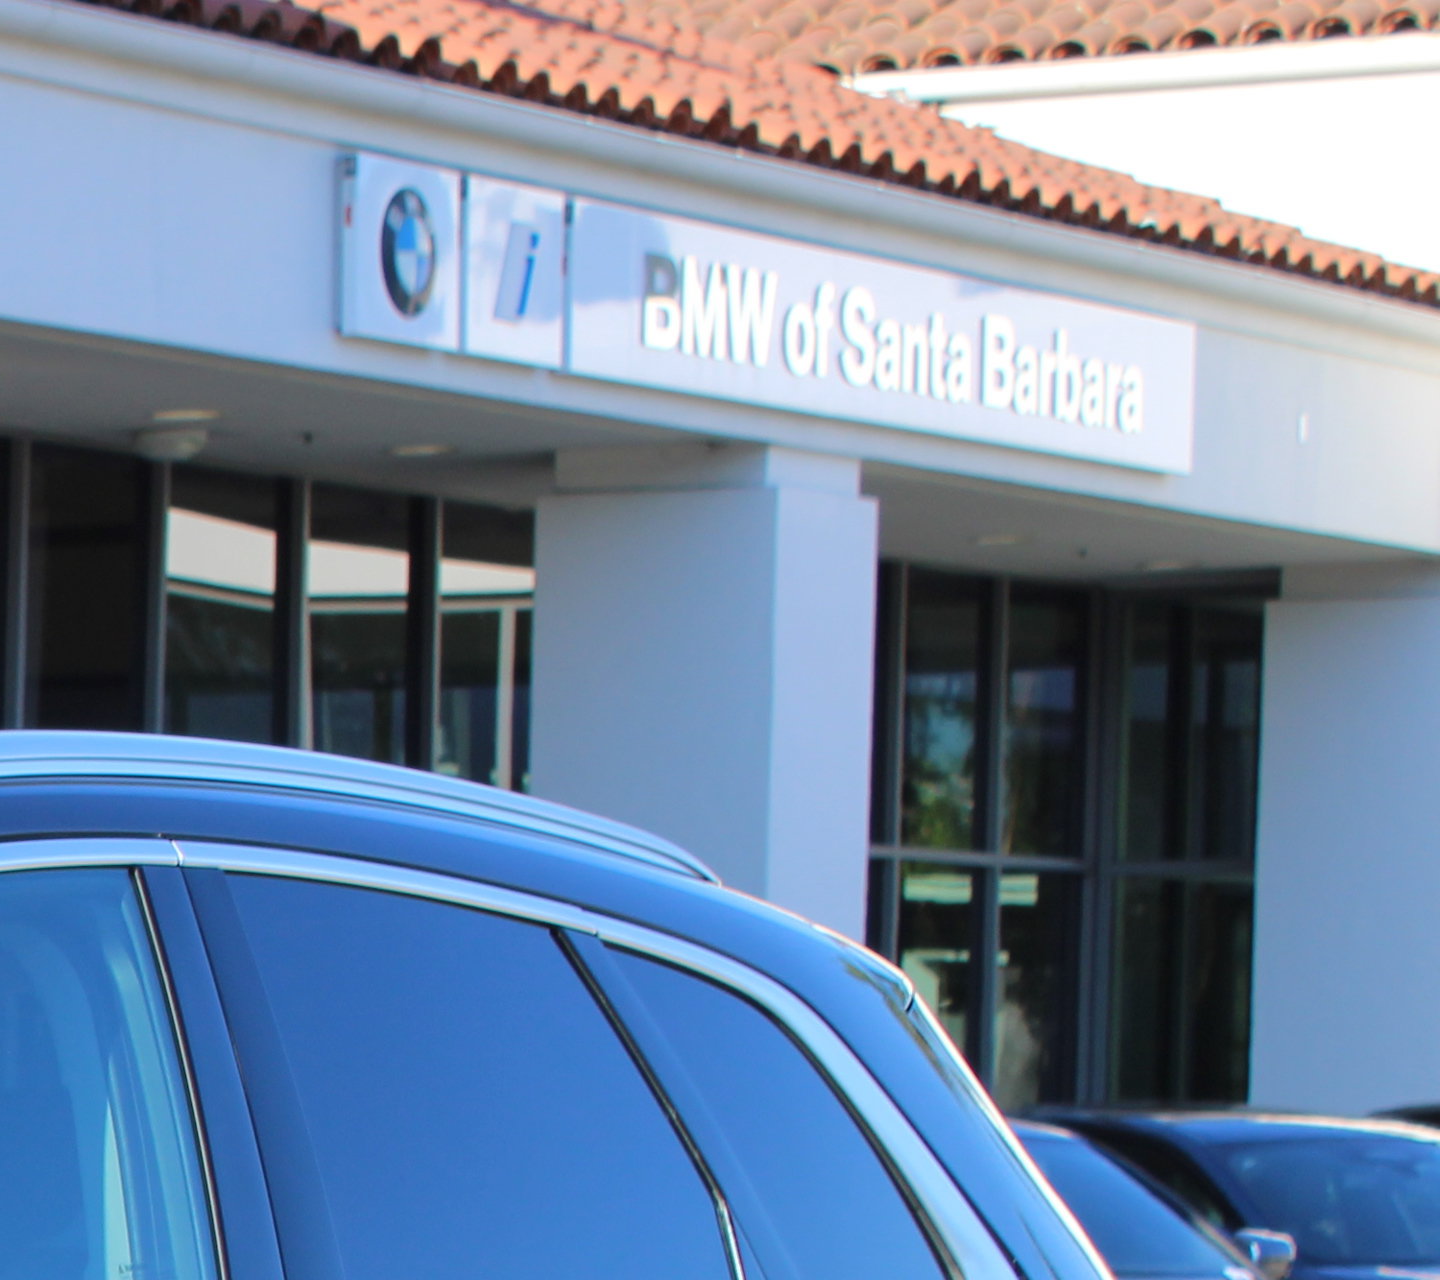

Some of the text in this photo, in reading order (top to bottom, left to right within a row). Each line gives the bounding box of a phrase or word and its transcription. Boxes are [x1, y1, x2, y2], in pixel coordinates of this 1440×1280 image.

[642, 253, 1144, 434] BMW of Santa Barbara
